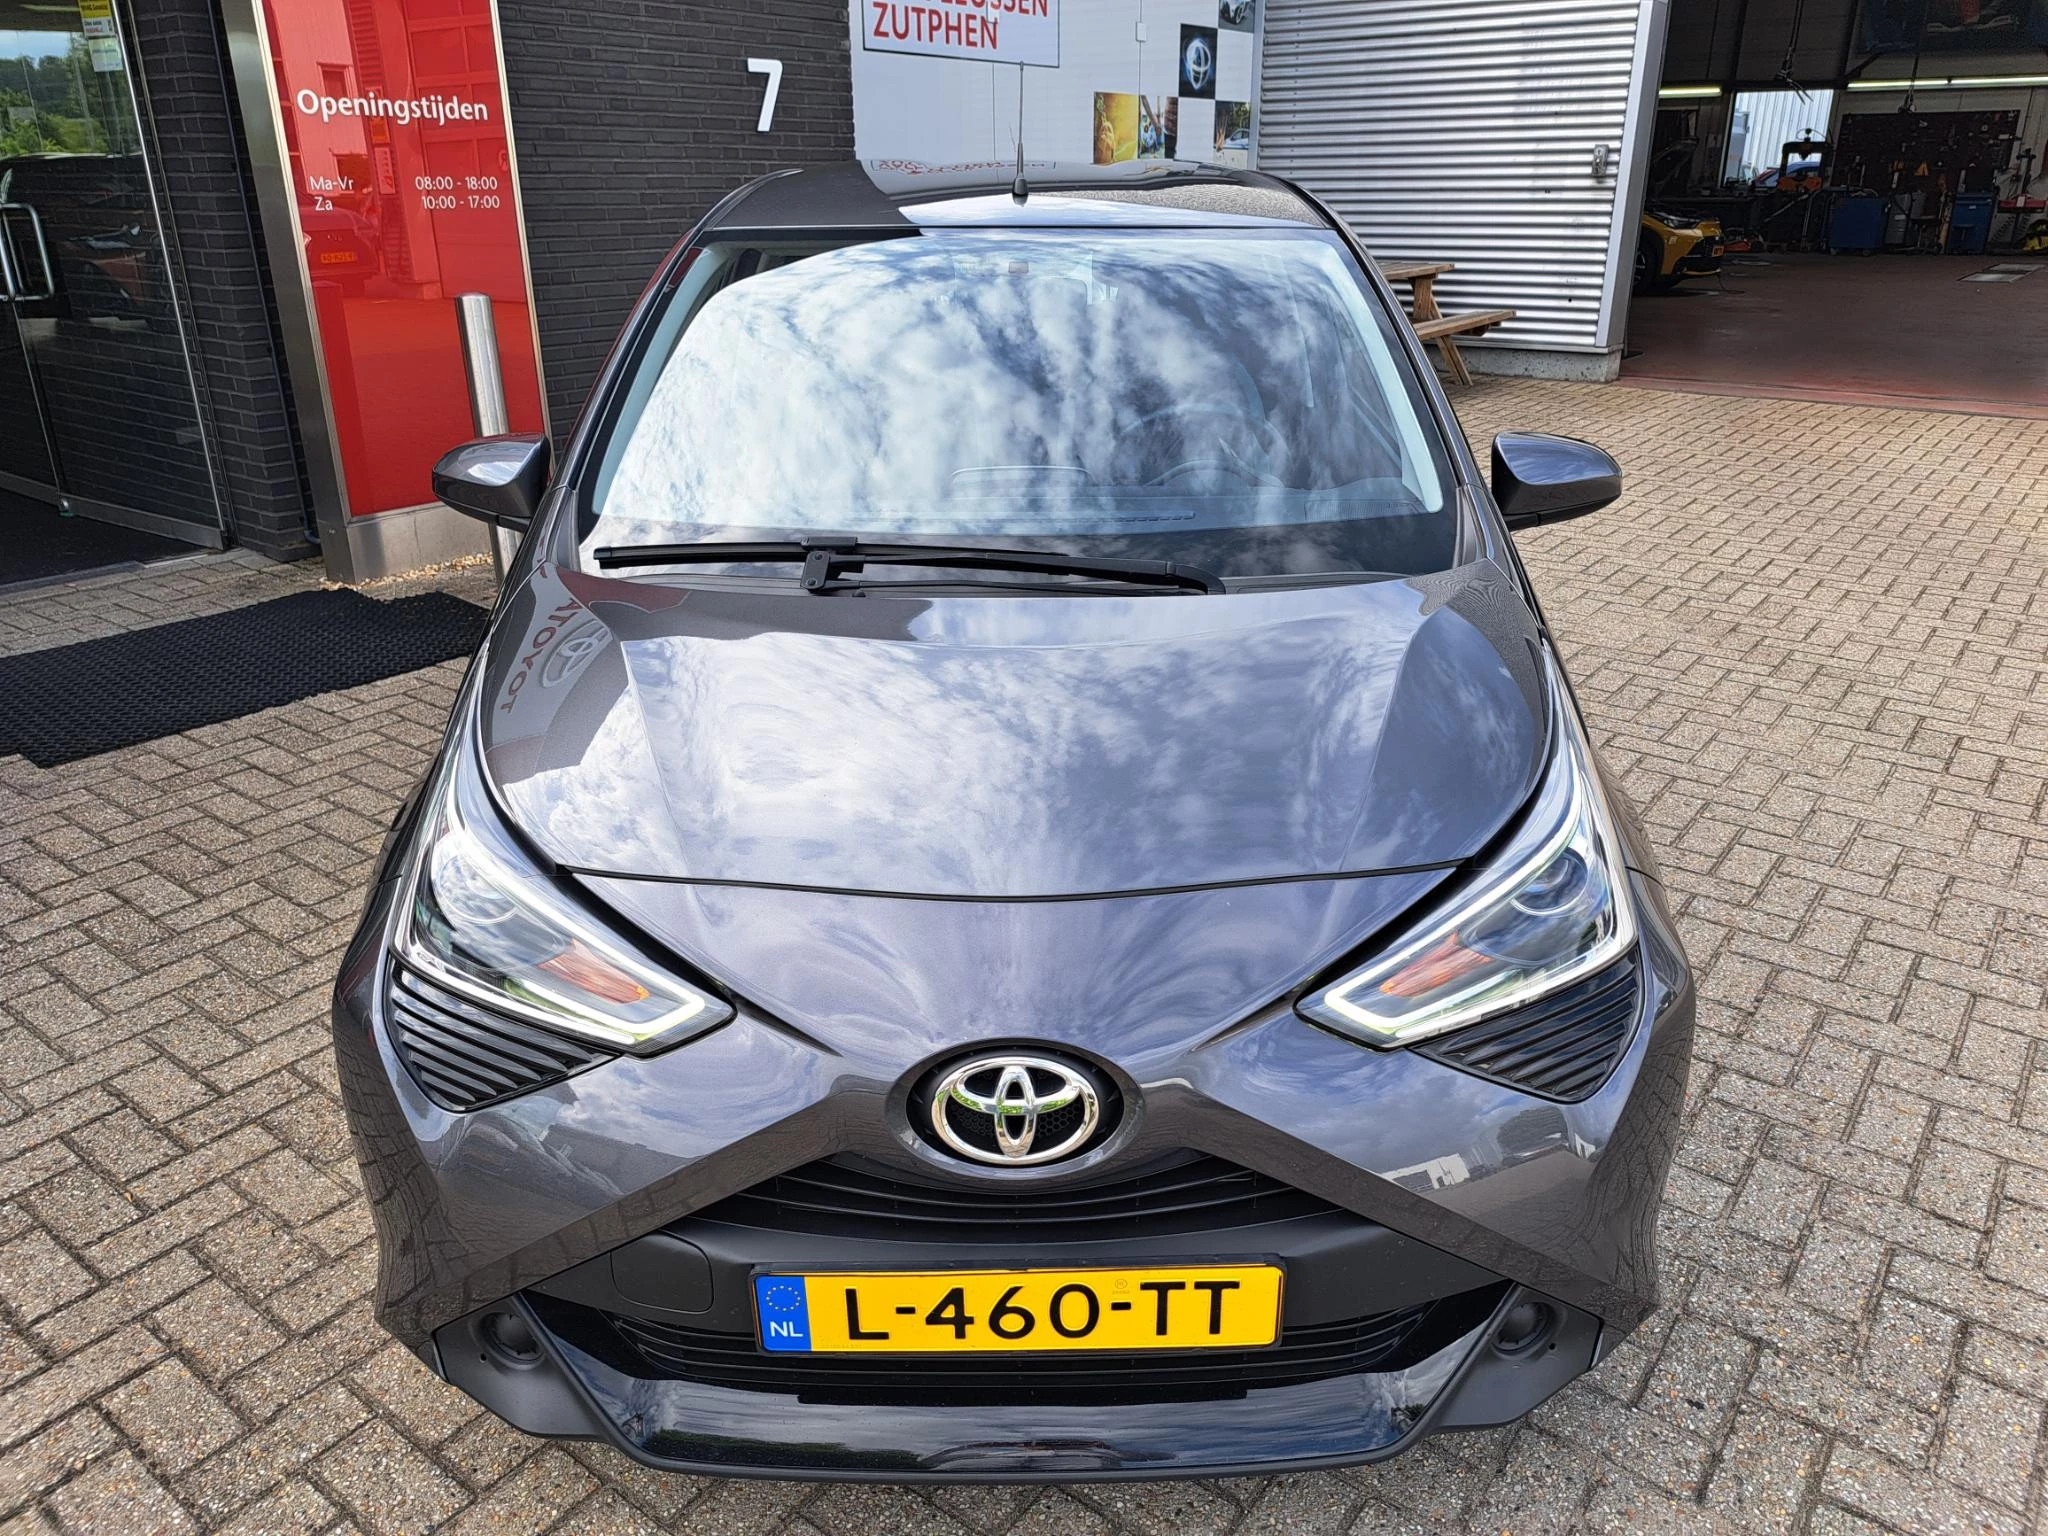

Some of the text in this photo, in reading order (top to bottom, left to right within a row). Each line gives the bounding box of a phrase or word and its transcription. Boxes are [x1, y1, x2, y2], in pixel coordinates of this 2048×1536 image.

[872, 2, 999, 49] ZUTPHEN
[297, 89, 489, 126] Openingstijden
[747, 57, 783, 132] 7
[309, 176, 354, 191] Ma-Vr
[415, 176, 454, 190] 08:00
[465, 176, 498, 190] 18:00
[314, 196, 334, 211] Za
[422, 196, 456, 209] 10:00
[468, 196, 500, 209] 17:00
[769, 1320, 804, 1338] NL
[845, 1280, 1241, 1341] L-460-TT
